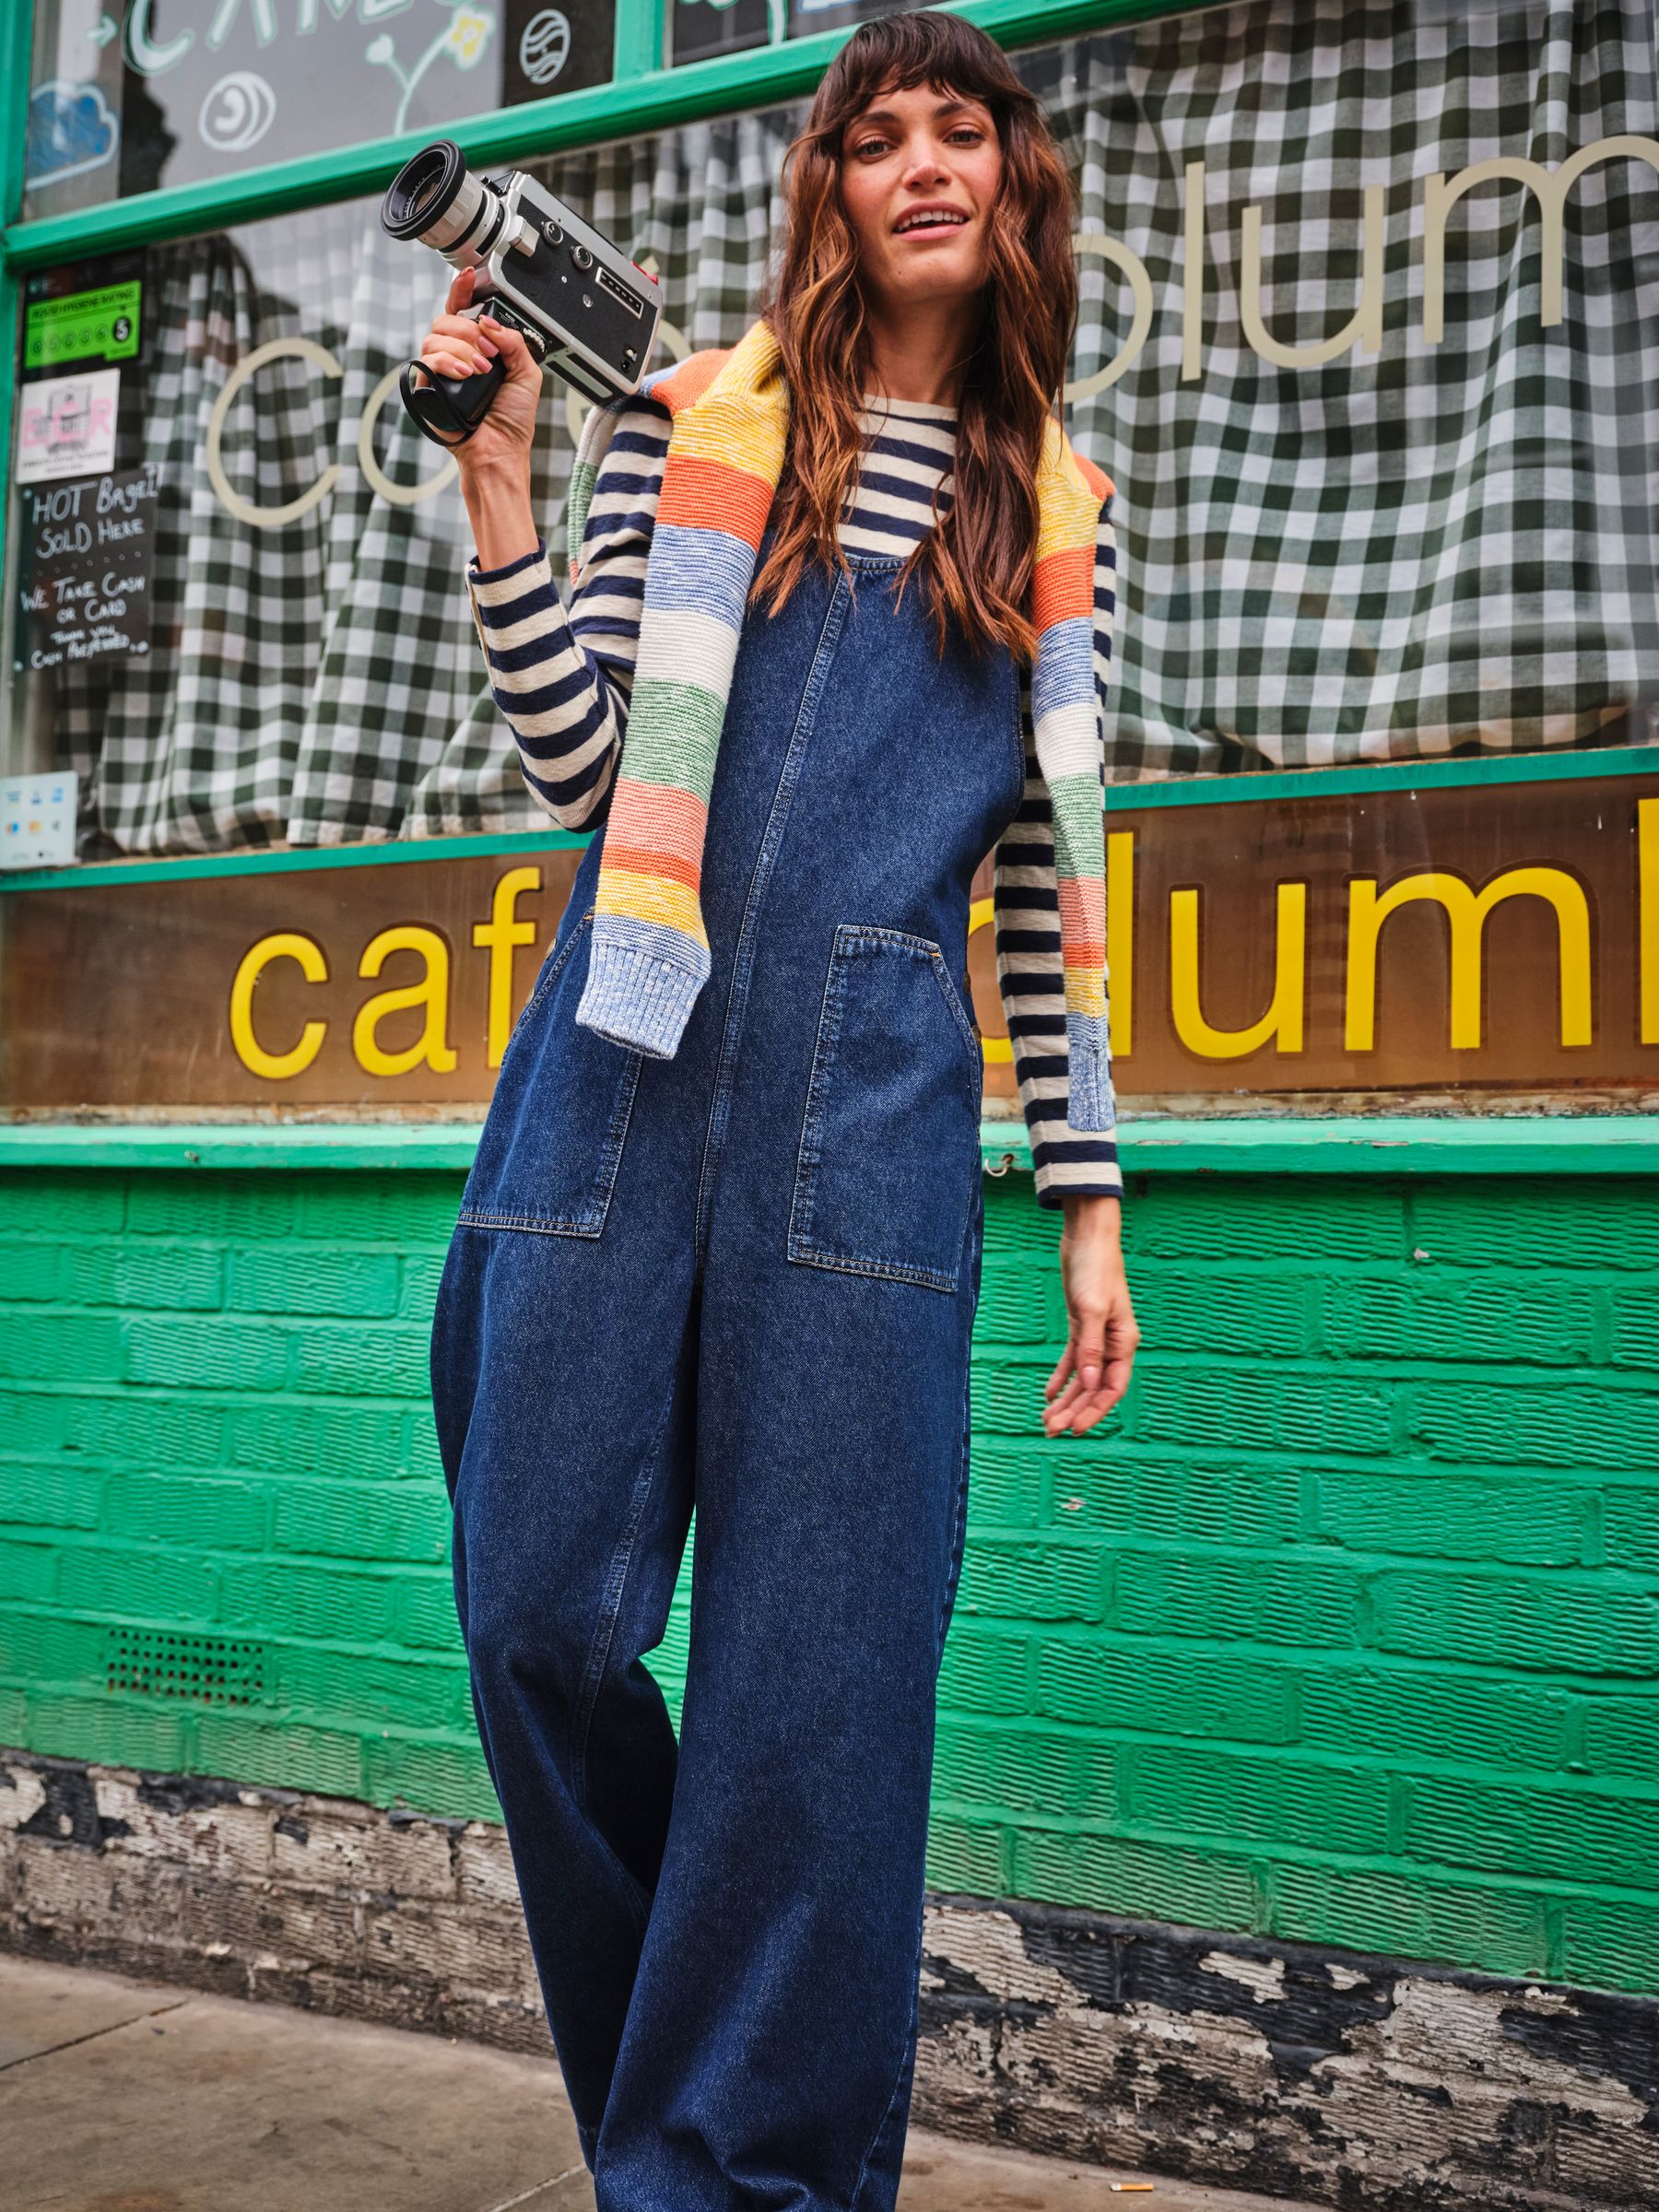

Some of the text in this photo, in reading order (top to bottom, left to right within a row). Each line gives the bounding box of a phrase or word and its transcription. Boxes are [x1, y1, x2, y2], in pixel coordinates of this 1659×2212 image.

[32, 480, 98, 524] HOT
[36, 522, 92, 559] SOLD
[20, 584, 50, 612] WE
[230, 866, 540, 1078] caf
